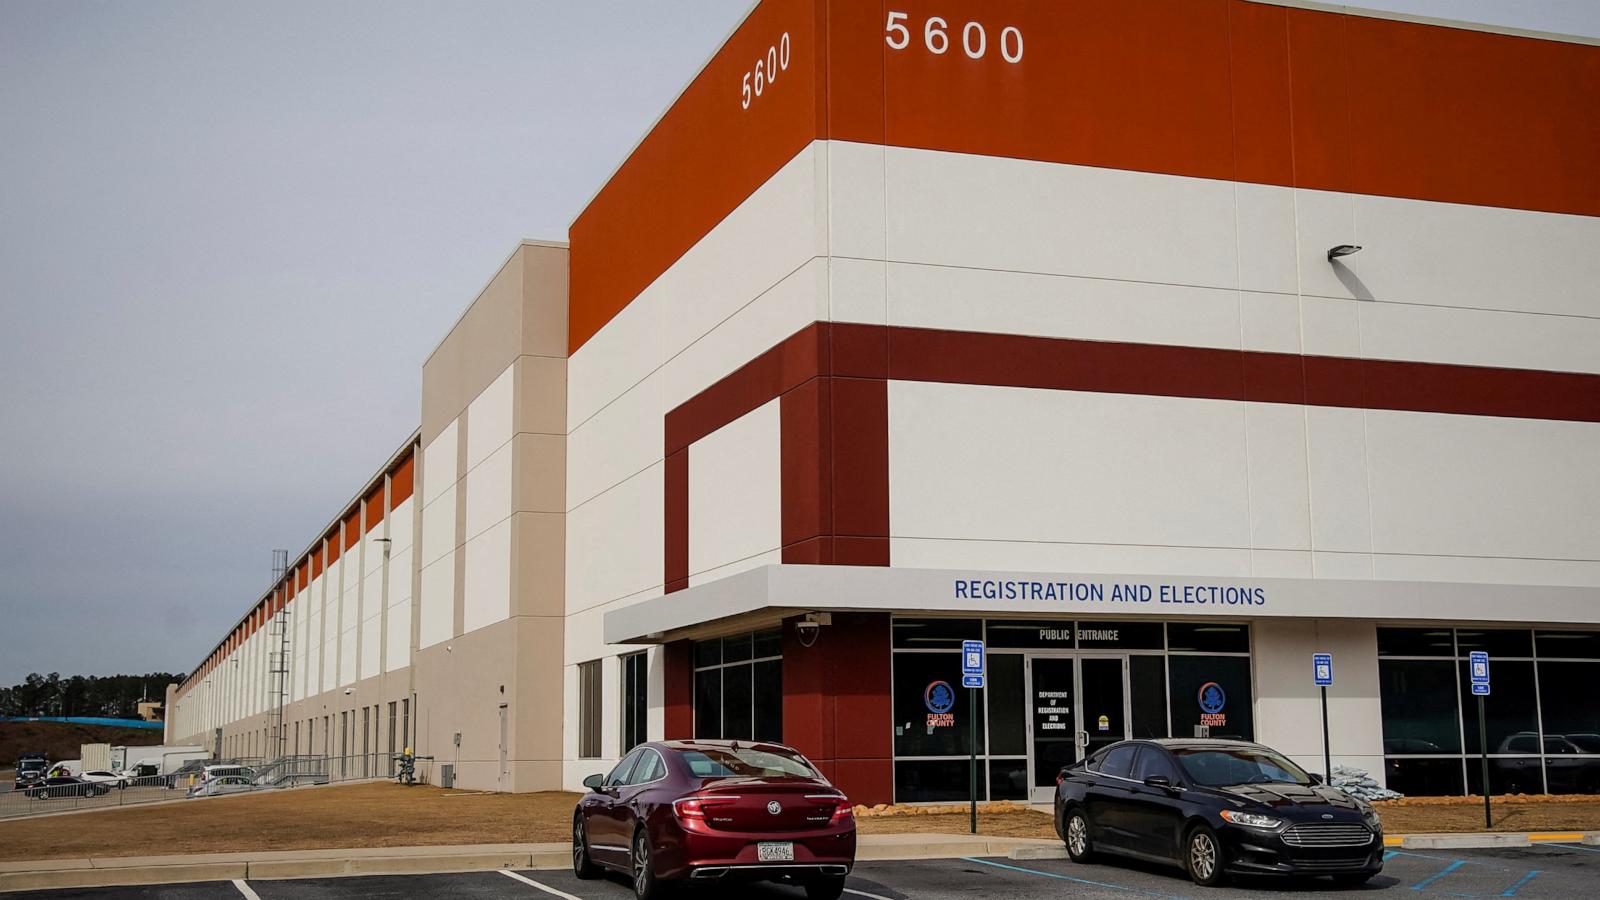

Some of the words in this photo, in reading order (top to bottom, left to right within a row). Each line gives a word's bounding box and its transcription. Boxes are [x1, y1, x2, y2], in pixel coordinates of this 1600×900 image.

[885, 11, 1024, 64] 5600
[742, 32, 790, 110] 5600
[955, 580, 1103, 601] REGISTRATION
[1111, 584, 1152, 602] AND
[1160, 586, 1265, 605] ELECTIONS
[1039, 629, 1070, 640] PUBLIC
[1077, 629, 1119, 640] ENTRANCE
[926, 719, 954, 727] COUNTY
[1200, 719, 1226, 727] COUNTY
